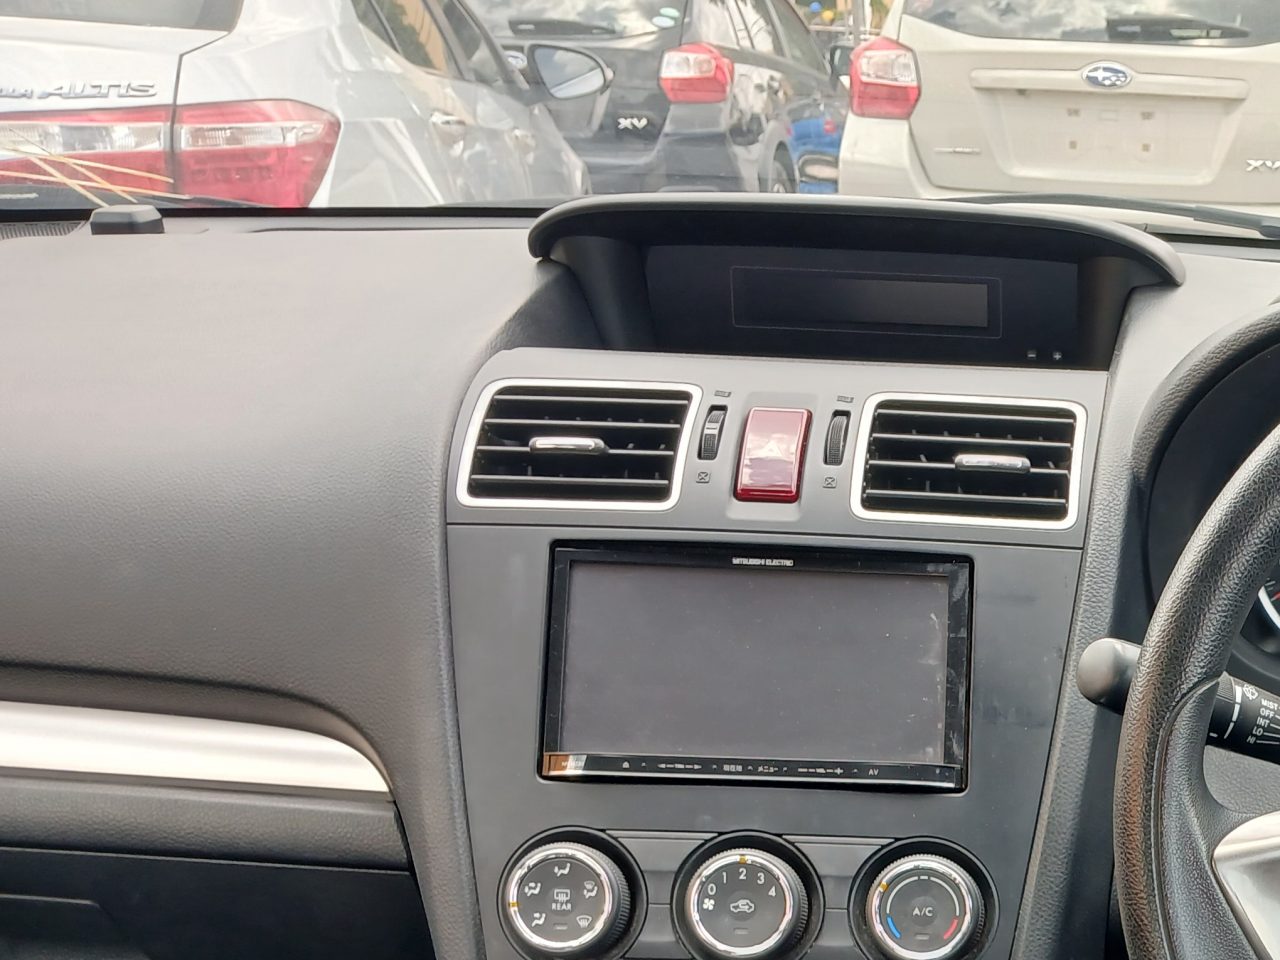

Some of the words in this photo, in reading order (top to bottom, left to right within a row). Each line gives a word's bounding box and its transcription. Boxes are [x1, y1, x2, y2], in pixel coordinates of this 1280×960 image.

[37, 80, 157, 99] ALTIS
[617, 117, 648, 130] XV
[1261, 698, 1279, 710] MIST
[1260, 708, 1275, 719] OFF
[1256, 716, 1270, 728] INT
[1252, 726, 1264, 736] LO
[1246, 735, 1257, 744] HI
[868, 768, 879, 776] AV
[707, 883, 717, 896] 0
[722, 871, 727, 884] 1
[738, 867, 747, 880] 2
[757, 872, 765, 885] 3
[768, 885, 777, 897] 4
[551, 902, 572, 912] REAR
[912, 905, 934, 917] A/C
